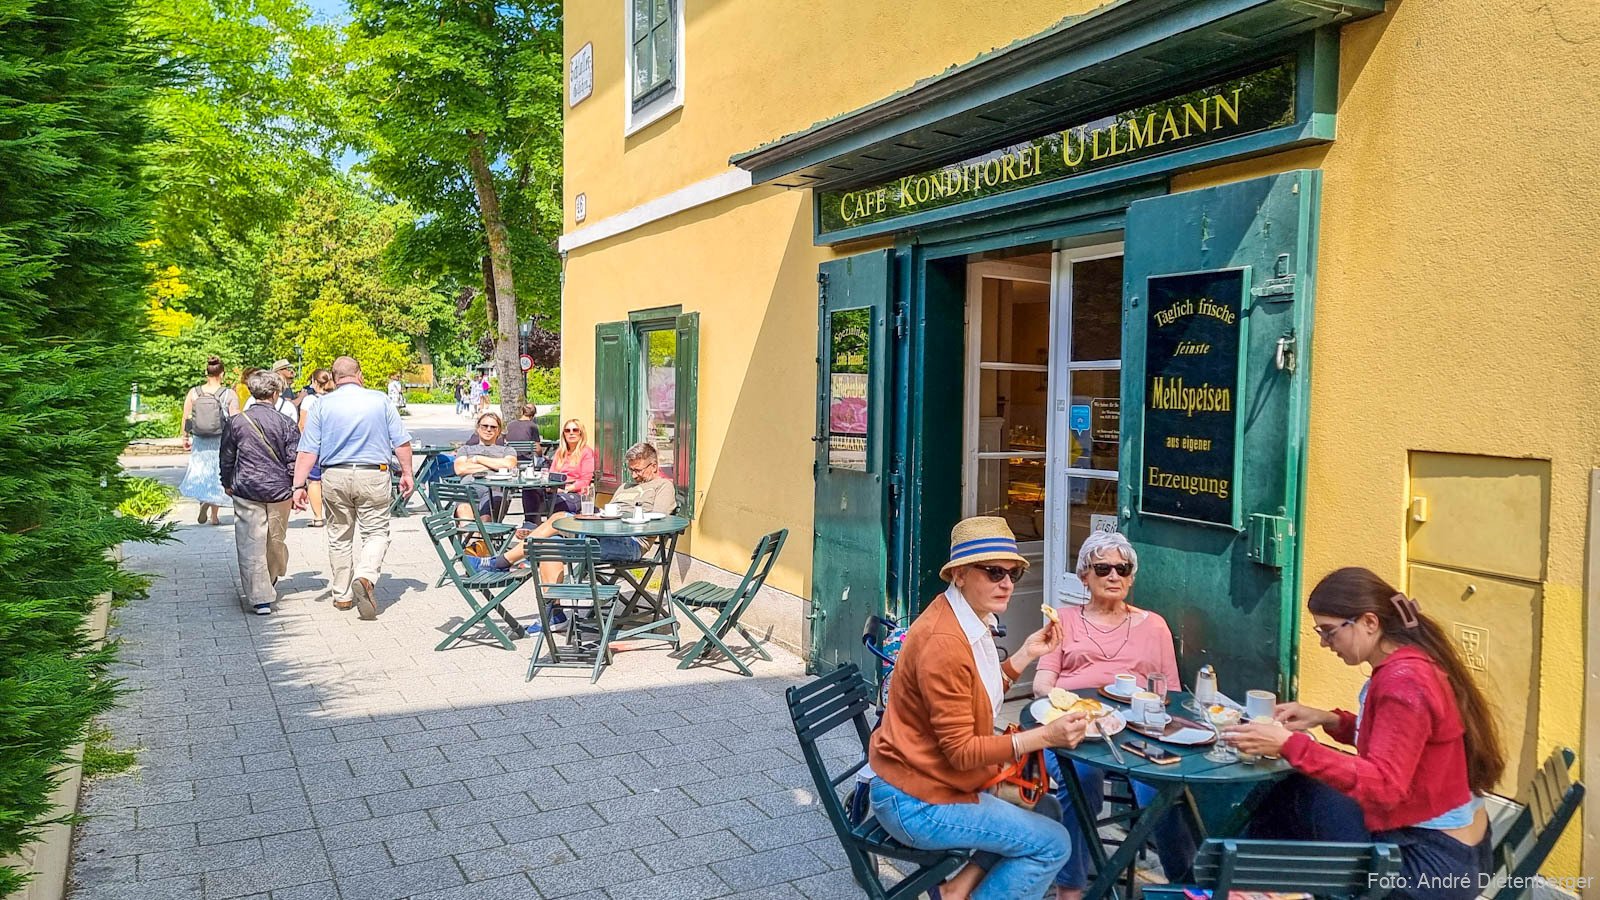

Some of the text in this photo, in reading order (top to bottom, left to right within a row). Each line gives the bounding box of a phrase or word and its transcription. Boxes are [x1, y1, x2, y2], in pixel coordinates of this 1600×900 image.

[840, 88, 1243, 222] CAFE KONDITOREI ULLMANN
[1154, 298, 1236, 328] Täglich frische
[1174, 341, 1211, 357] feinste
[1152, 376, 1231, 417] Mehlspeisen
[1166, 435, 1212, 452] aus eigener
[1148, 466, 1229, 499] Erzeugung
